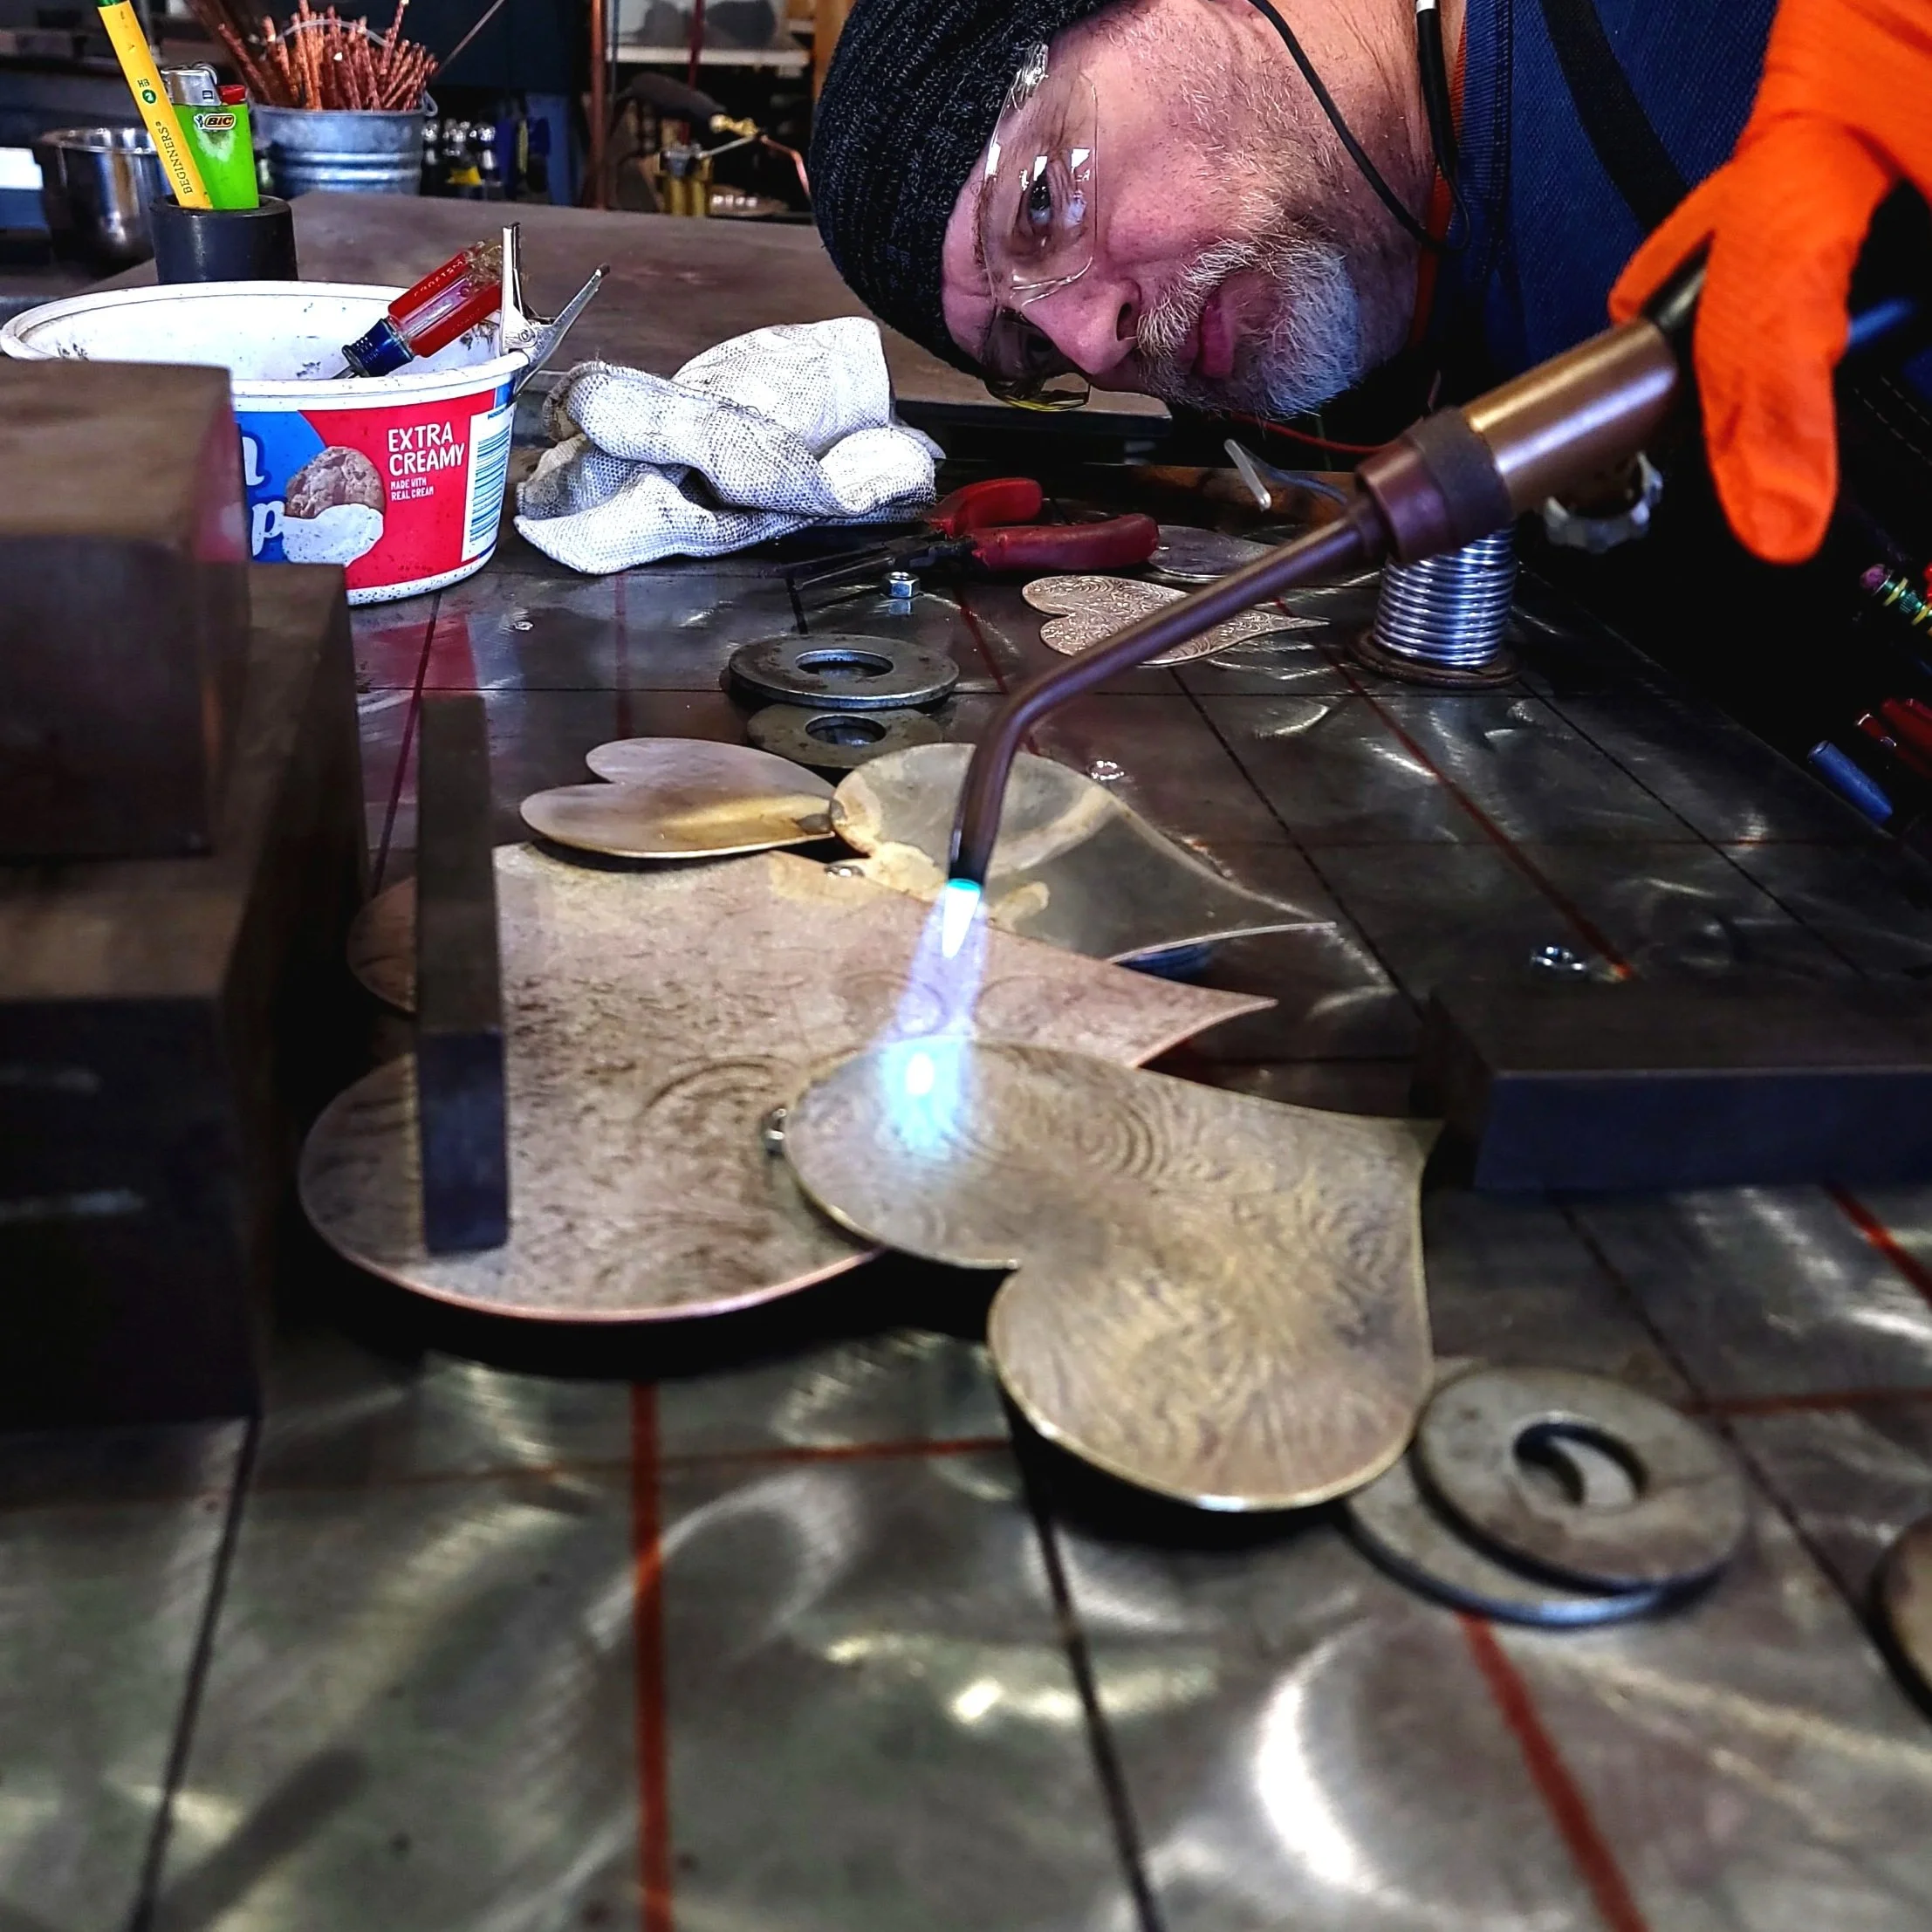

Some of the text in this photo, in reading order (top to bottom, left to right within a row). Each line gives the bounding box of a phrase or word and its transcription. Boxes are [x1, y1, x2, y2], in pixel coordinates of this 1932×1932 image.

[137, 78, 151, 88] HB
[206, 117, 233, 126] BIC
[387, 421, 454, 452] EXTRA
[389, 442, 465, 476] CREAMY
[390, 476, 427, 490] MADE WITH
[391, 486, 435, 501] REAL CREAM
